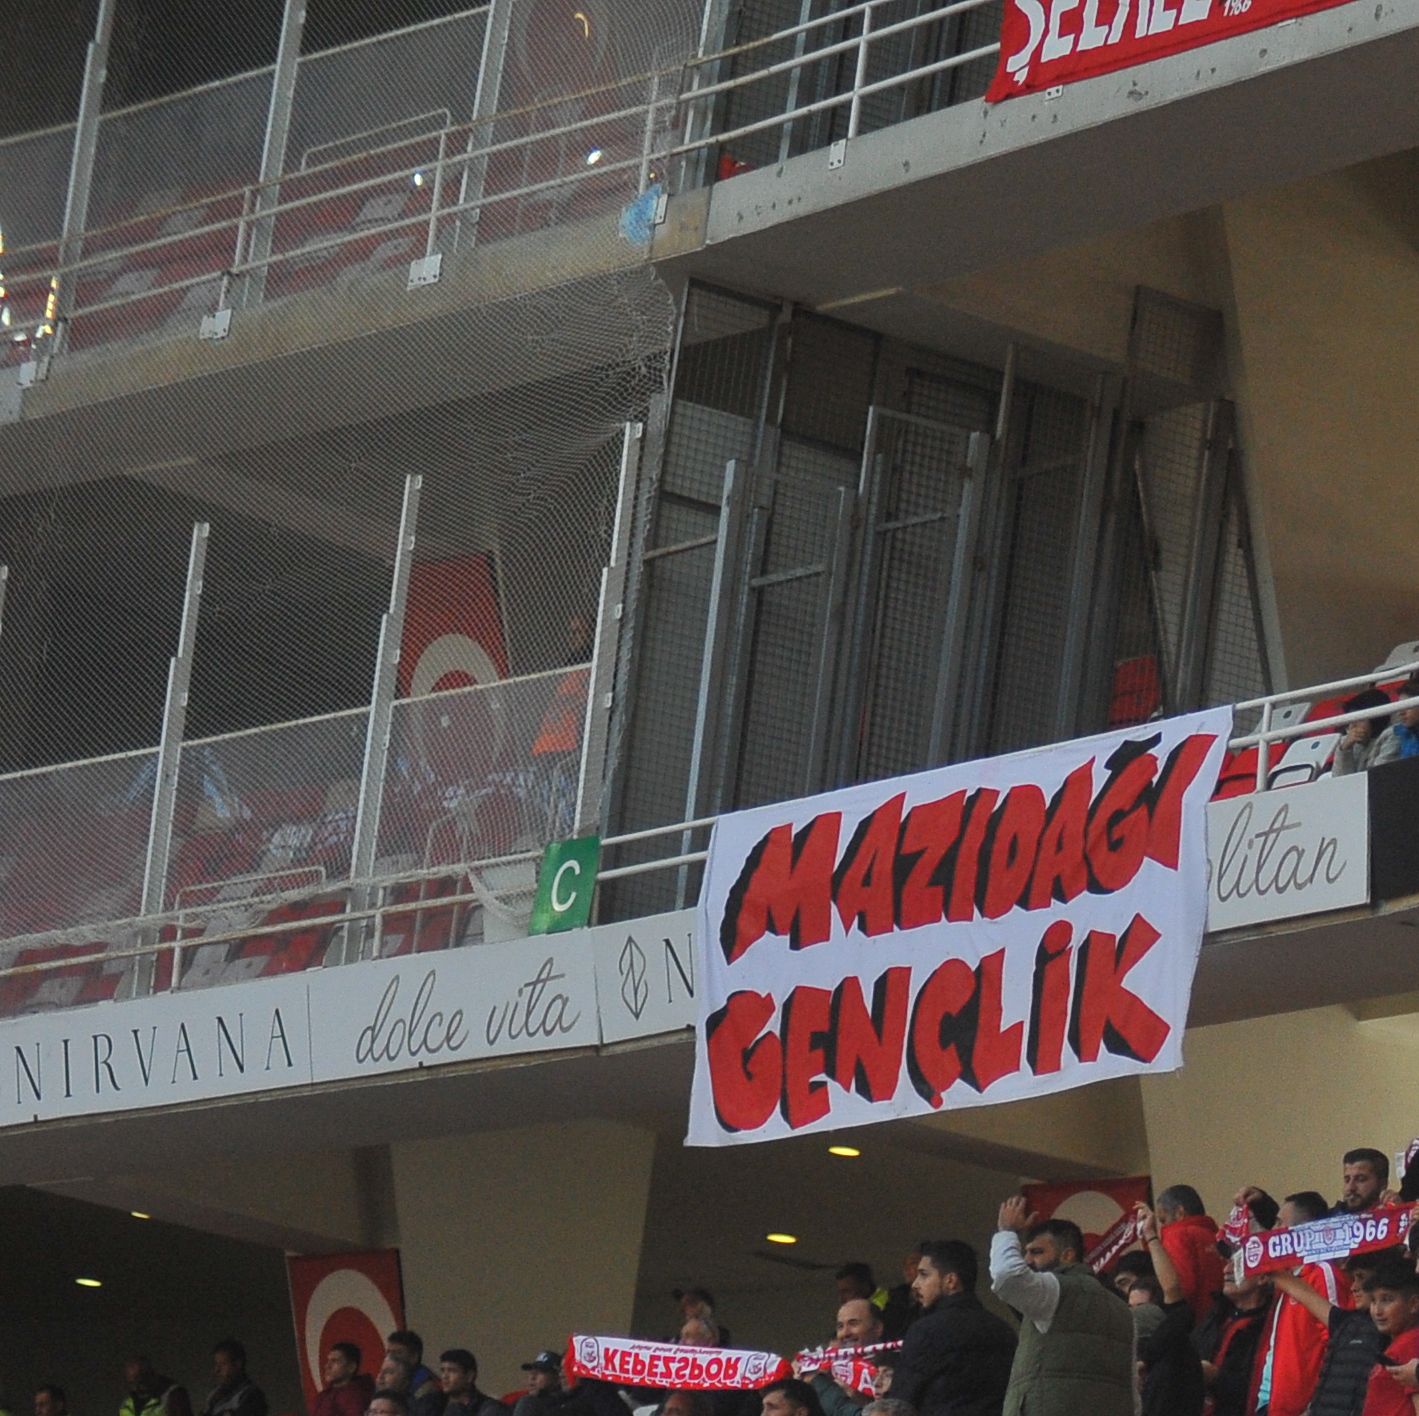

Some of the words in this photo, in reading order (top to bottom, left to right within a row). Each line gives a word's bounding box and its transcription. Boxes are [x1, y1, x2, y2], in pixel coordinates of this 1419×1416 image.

[1006, 0, 1211, 86] ŞEL
[550, 860, 580, 912] C
[719, 731, 1219, 966] MAZIDAĞI
[13, 1007, 295, 1105] NIRVANA
[355, 968, 470, 1065] dolce
[485, 957, 581, 1045] vita
[705, 913, 1171, 1133] GENÇLİK
[1267, 1229, 1317, 1259] GRUP
[1342, 1217, 1390, 1249] 1966
